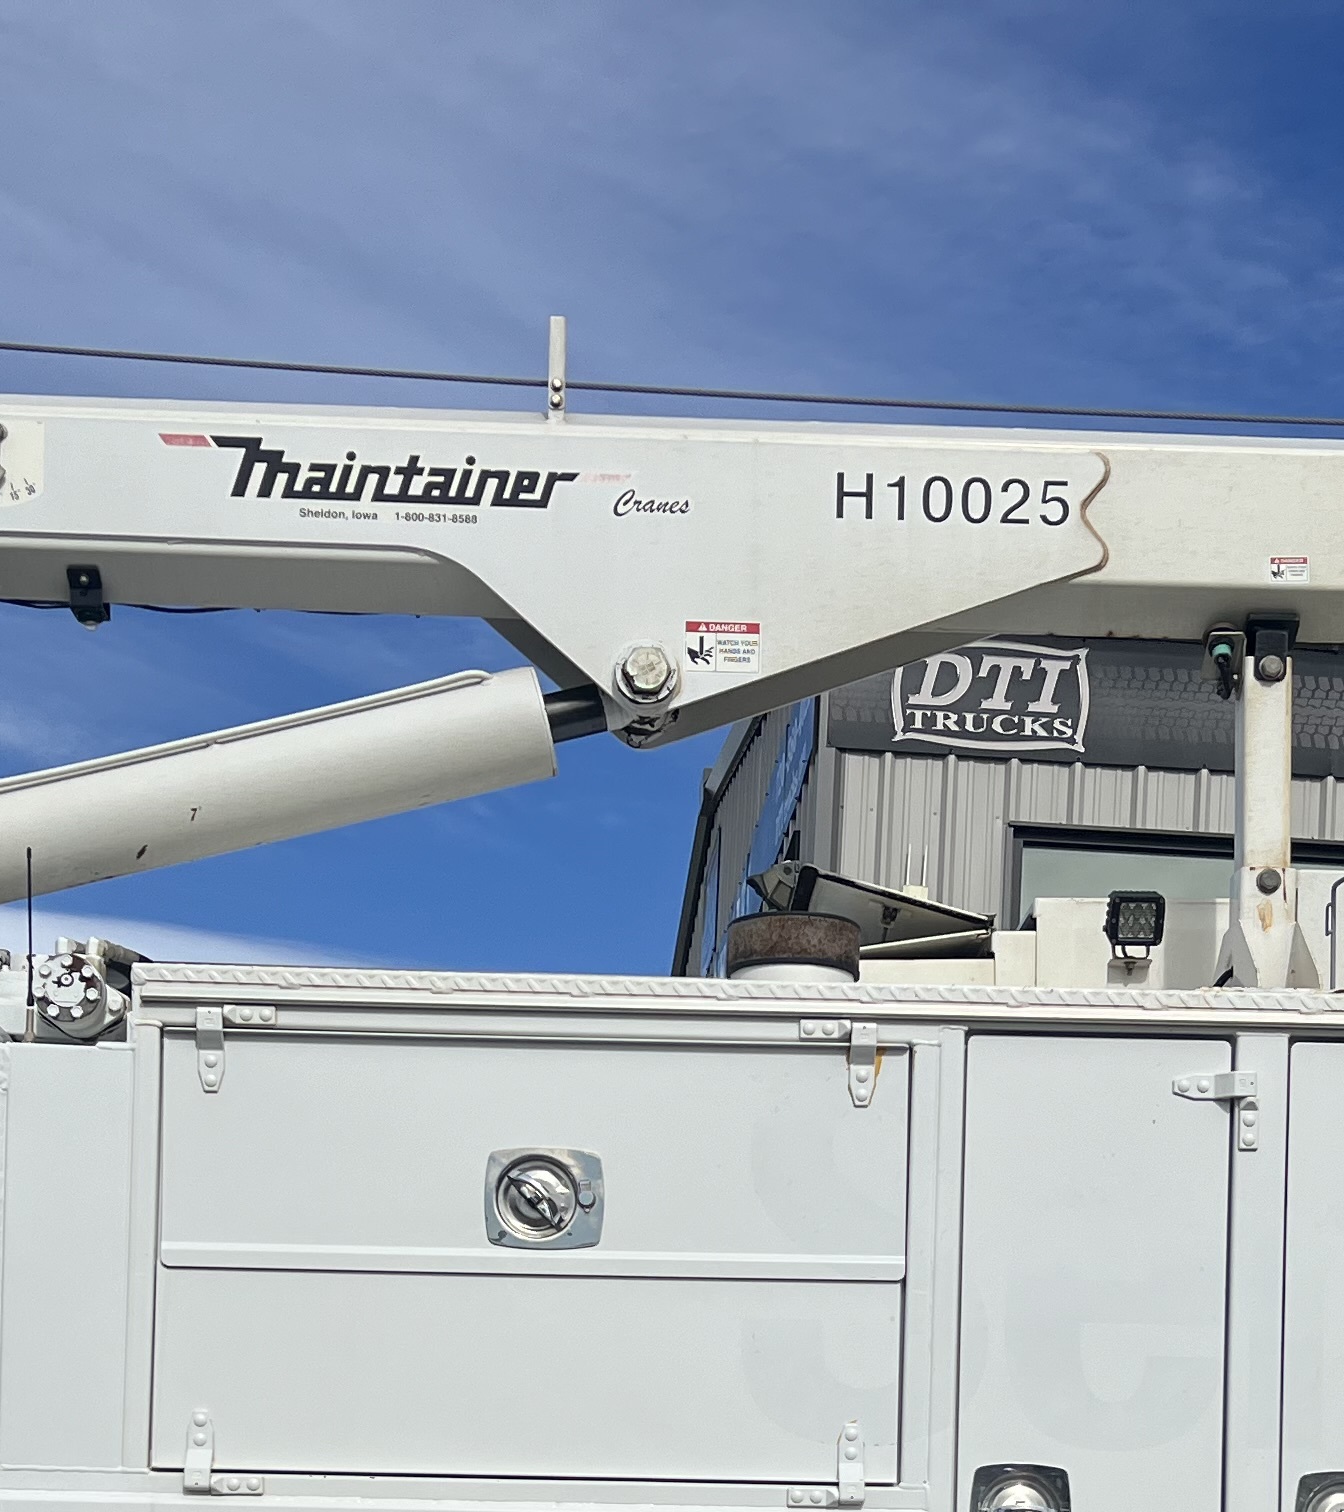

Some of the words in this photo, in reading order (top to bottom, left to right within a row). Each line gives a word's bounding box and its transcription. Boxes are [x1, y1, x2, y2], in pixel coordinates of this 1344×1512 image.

[210, 435, 580, 509] Maintainer
[613, 490, 690, 517] Cranes
[835, 471, 1072, 526] H10025
[299, 507, 349, 521] Sheldon,
[351, 511, 378, 521] Iowa
[709, 624, 748, 632] DANGER
[906, 653, 1073, 714] DTI
[905, 708, 1073, 738] TRUCKS
